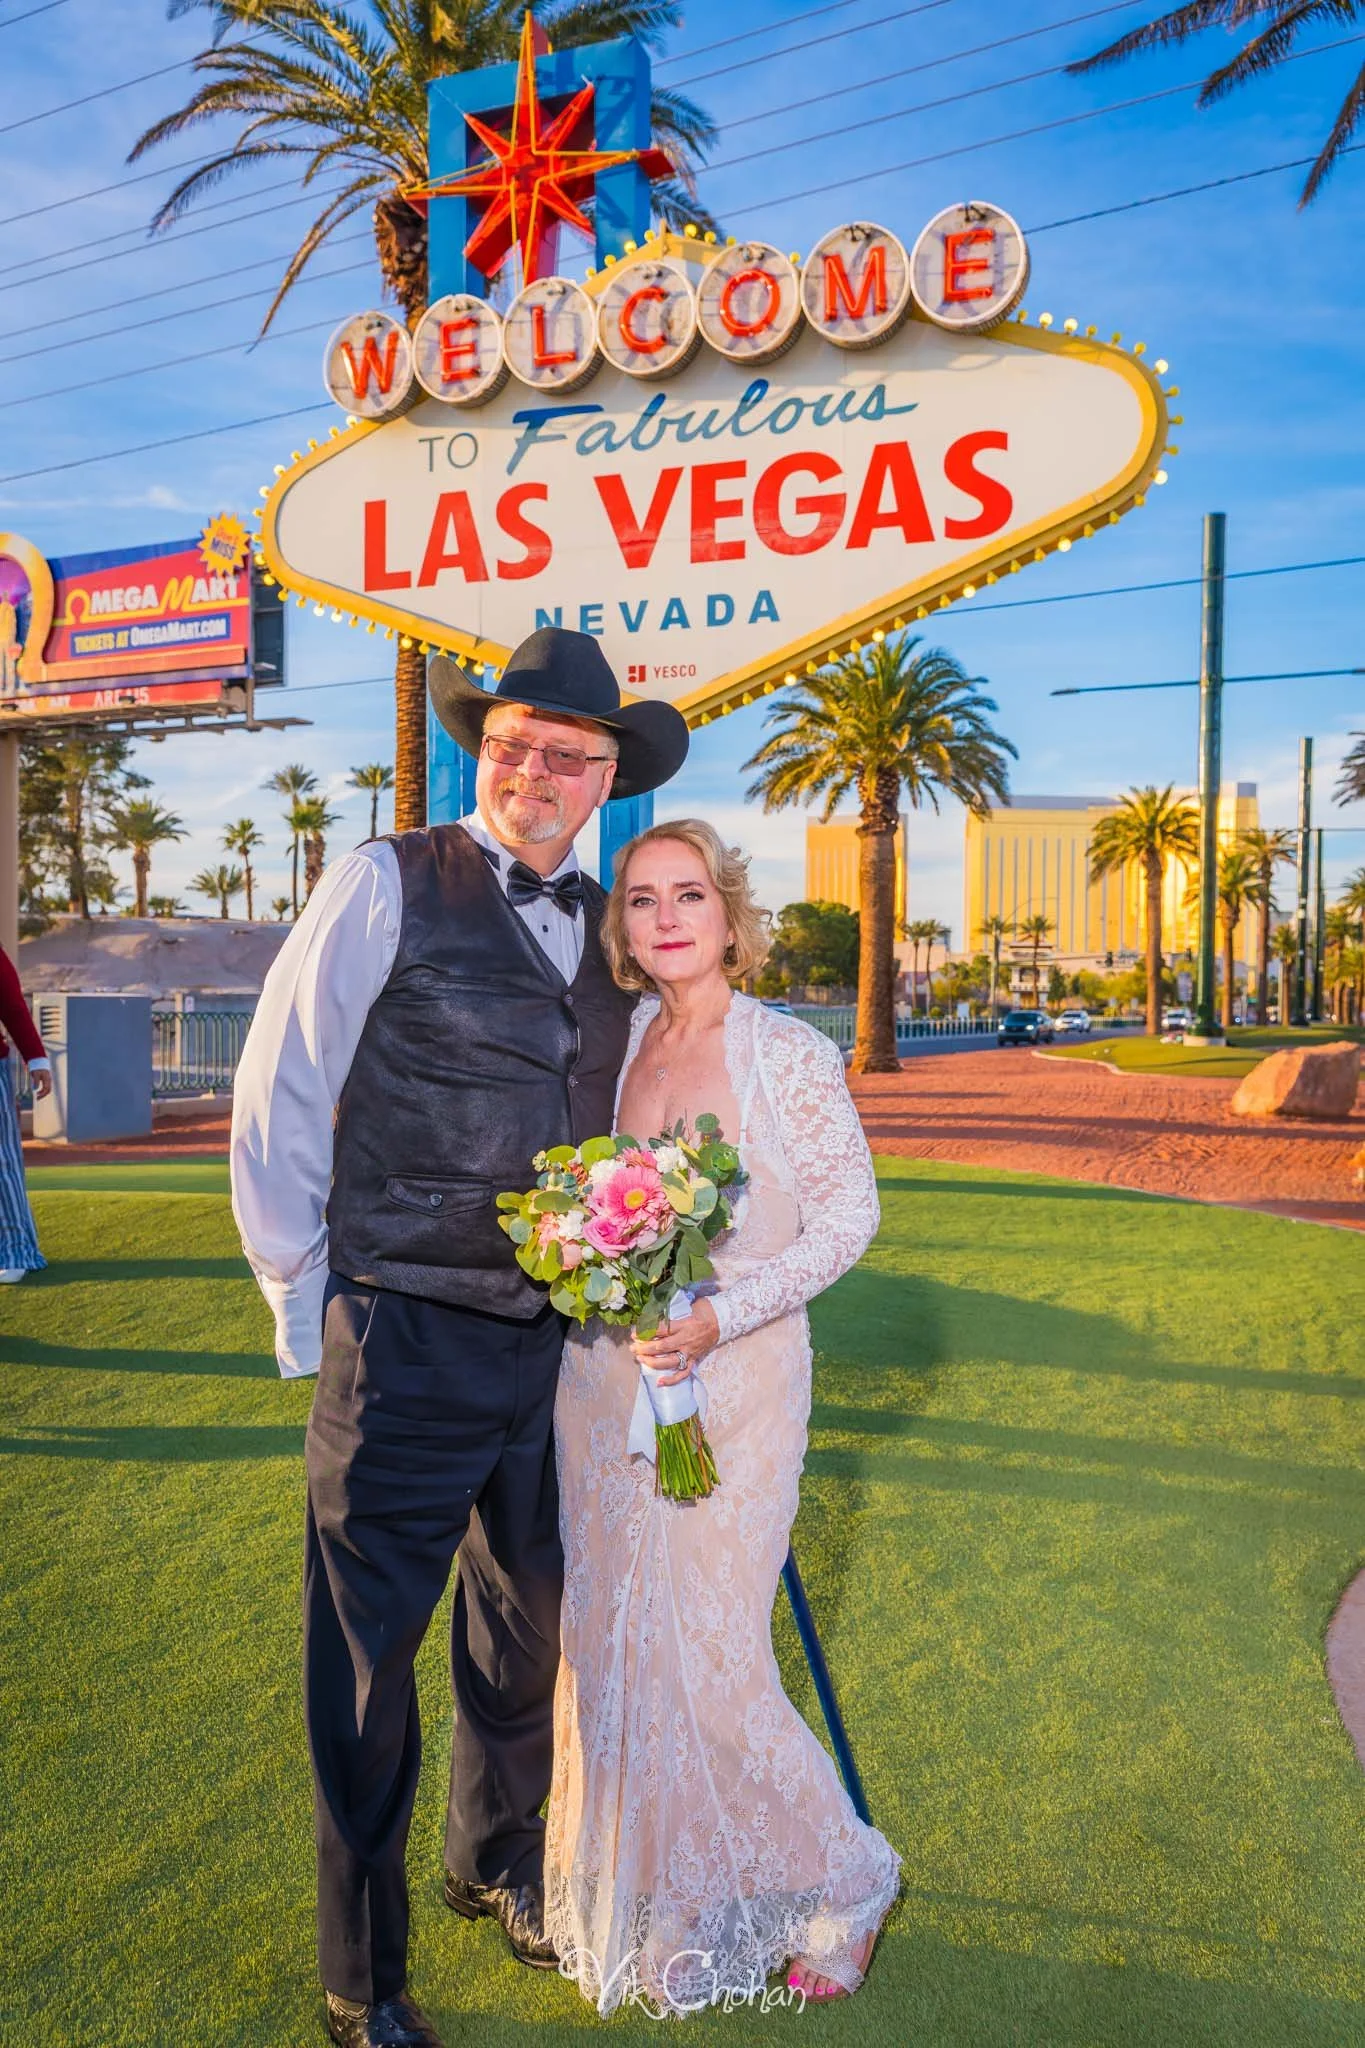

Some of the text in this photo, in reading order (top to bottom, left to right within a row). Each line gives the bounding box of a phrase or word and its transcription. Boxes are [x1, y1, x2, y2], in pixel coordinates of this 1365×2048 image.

[341, 227, 994, 399] WELCOME
[418, 377, 919, 475] TO Fabulous
[364, 431, 1014, 592] LAS VEGAS
[161, 574, 239, 613] MART
[535, 590, 781, 635] NEVADA
[74, 632, 115, 653] TICKETS
[116, 630, 129, 648] AT
[653, 664, 696, 679] YESCO
